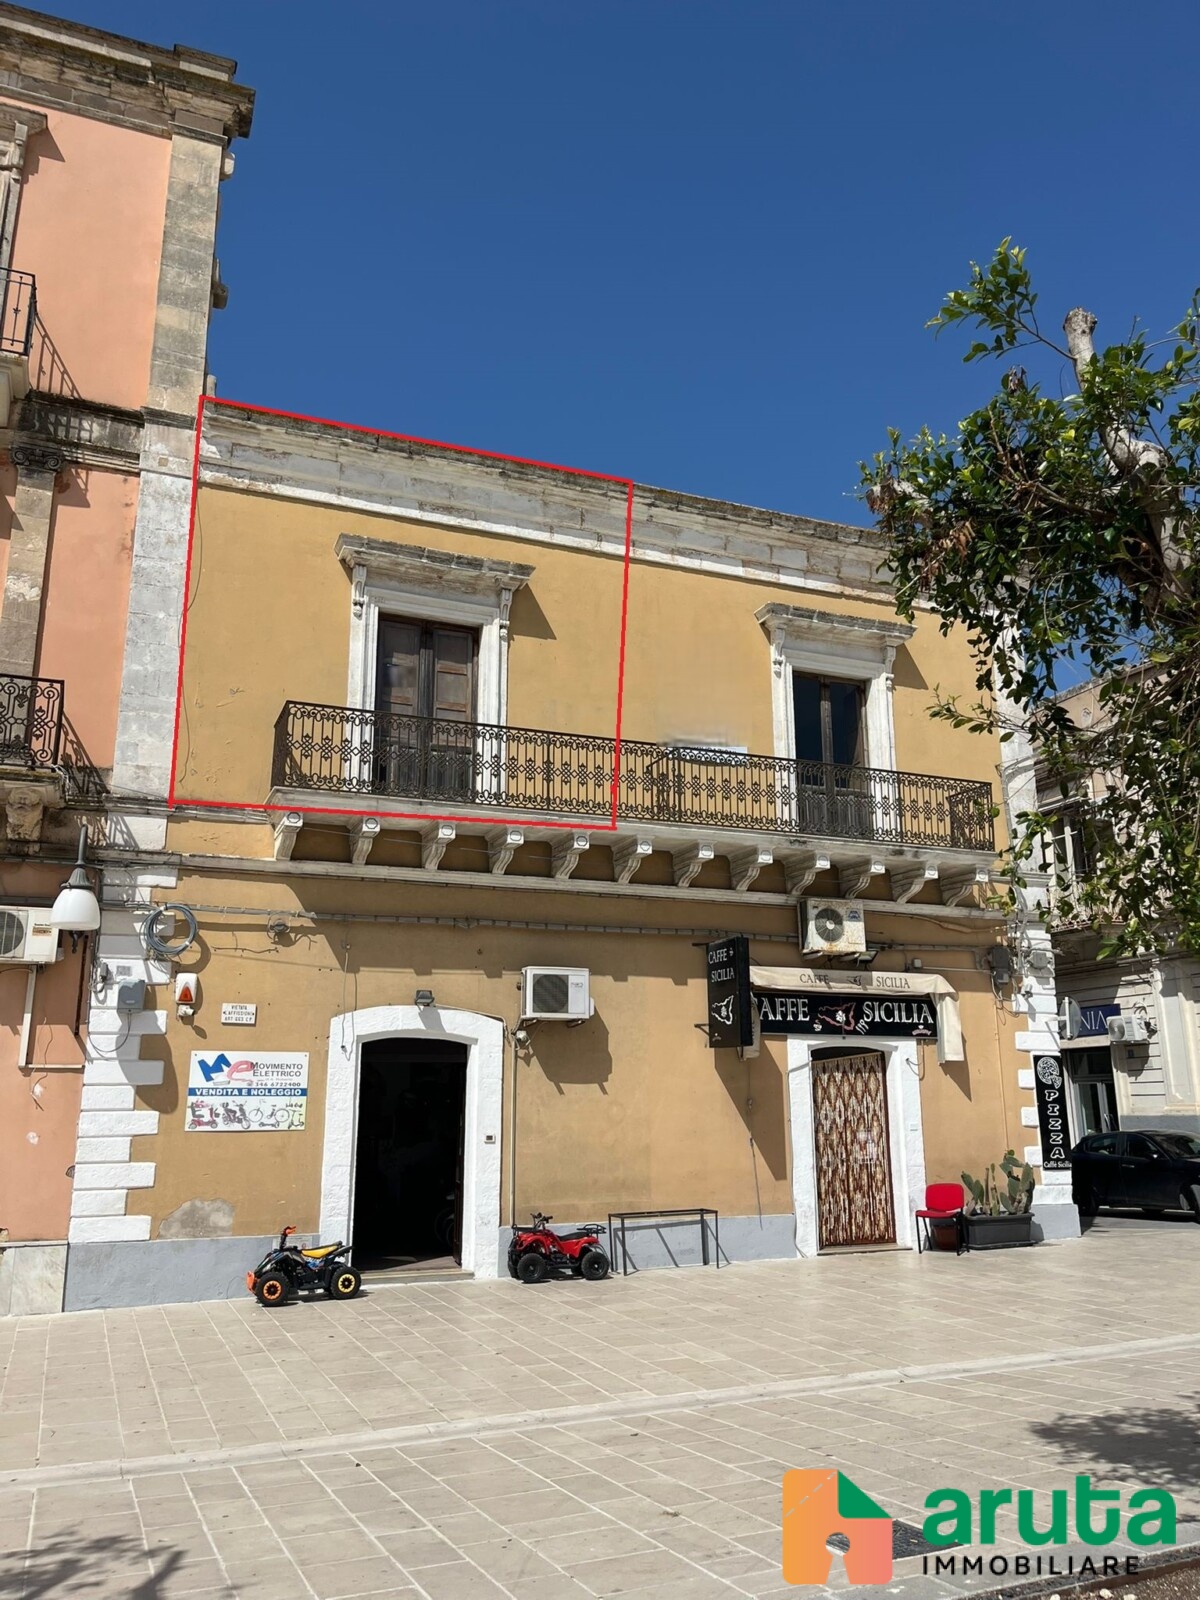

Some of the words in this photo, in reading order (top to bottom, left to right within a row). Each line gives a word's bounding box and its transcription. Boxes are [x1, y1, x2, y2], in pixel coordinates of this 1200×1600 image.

[711, 967, 735, 983] SICILIA
[875, 976, 911, 989] SICILIA
[863, 1001, 934, 1024] SICILIA
[251, 1062, 303, 1070] MOVIMENTO
[195, 1088, 239, 1096] VENDITA
[241, 1088, 249, 1096] E
[250, 1088, 302, 1096] NOLEGGIO
[1045, 1090, 1065, 1159] PIZZA
